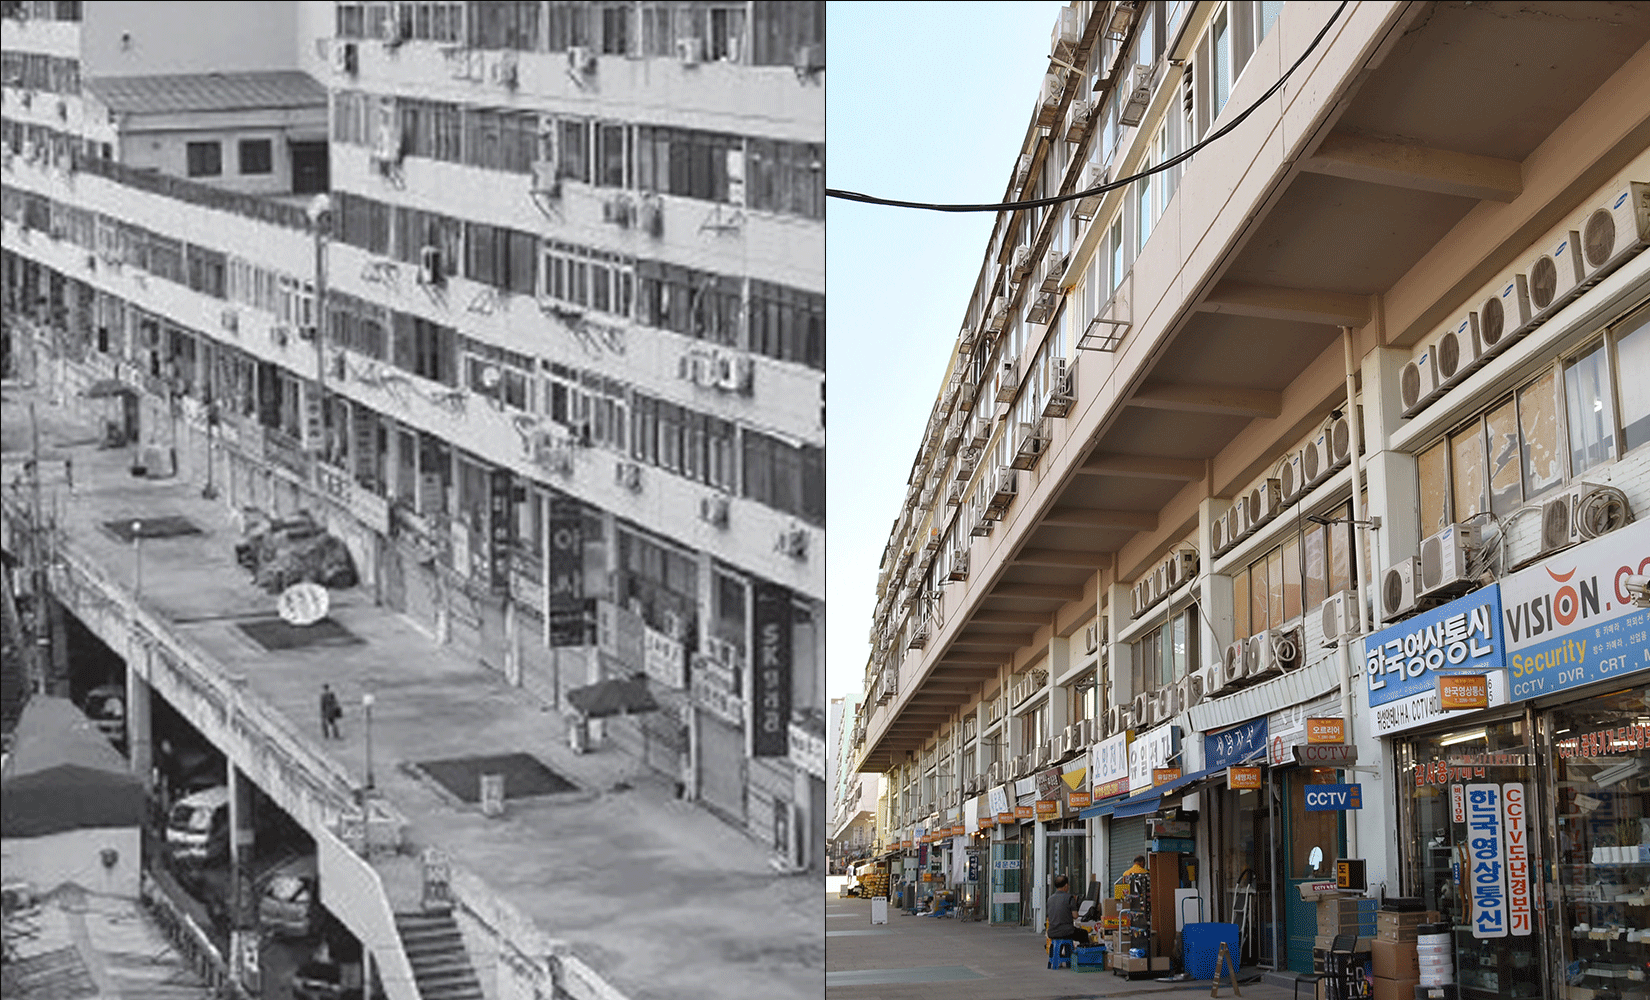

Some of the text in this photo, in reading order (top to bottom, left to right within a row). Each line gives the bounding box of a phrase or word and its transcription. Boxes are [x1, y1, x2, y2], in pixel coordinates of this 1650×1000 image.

[1367, 604, 1493, 691] 한국영상통신
[1512, 638, 1587, 678] Security
[1444, 685, 1485, 697] 한국영상통신
[1514, 677, 1545, 697] CCTV
[1558, 666, 1585, 685] DVR
[1599, 654, 1627, 674] CRT
[1306, 746, 1350, 760] CCTV
[1306, 791, 1347, 806] CCTV
[1469, 789, 1503, 933] 한국영상통신
